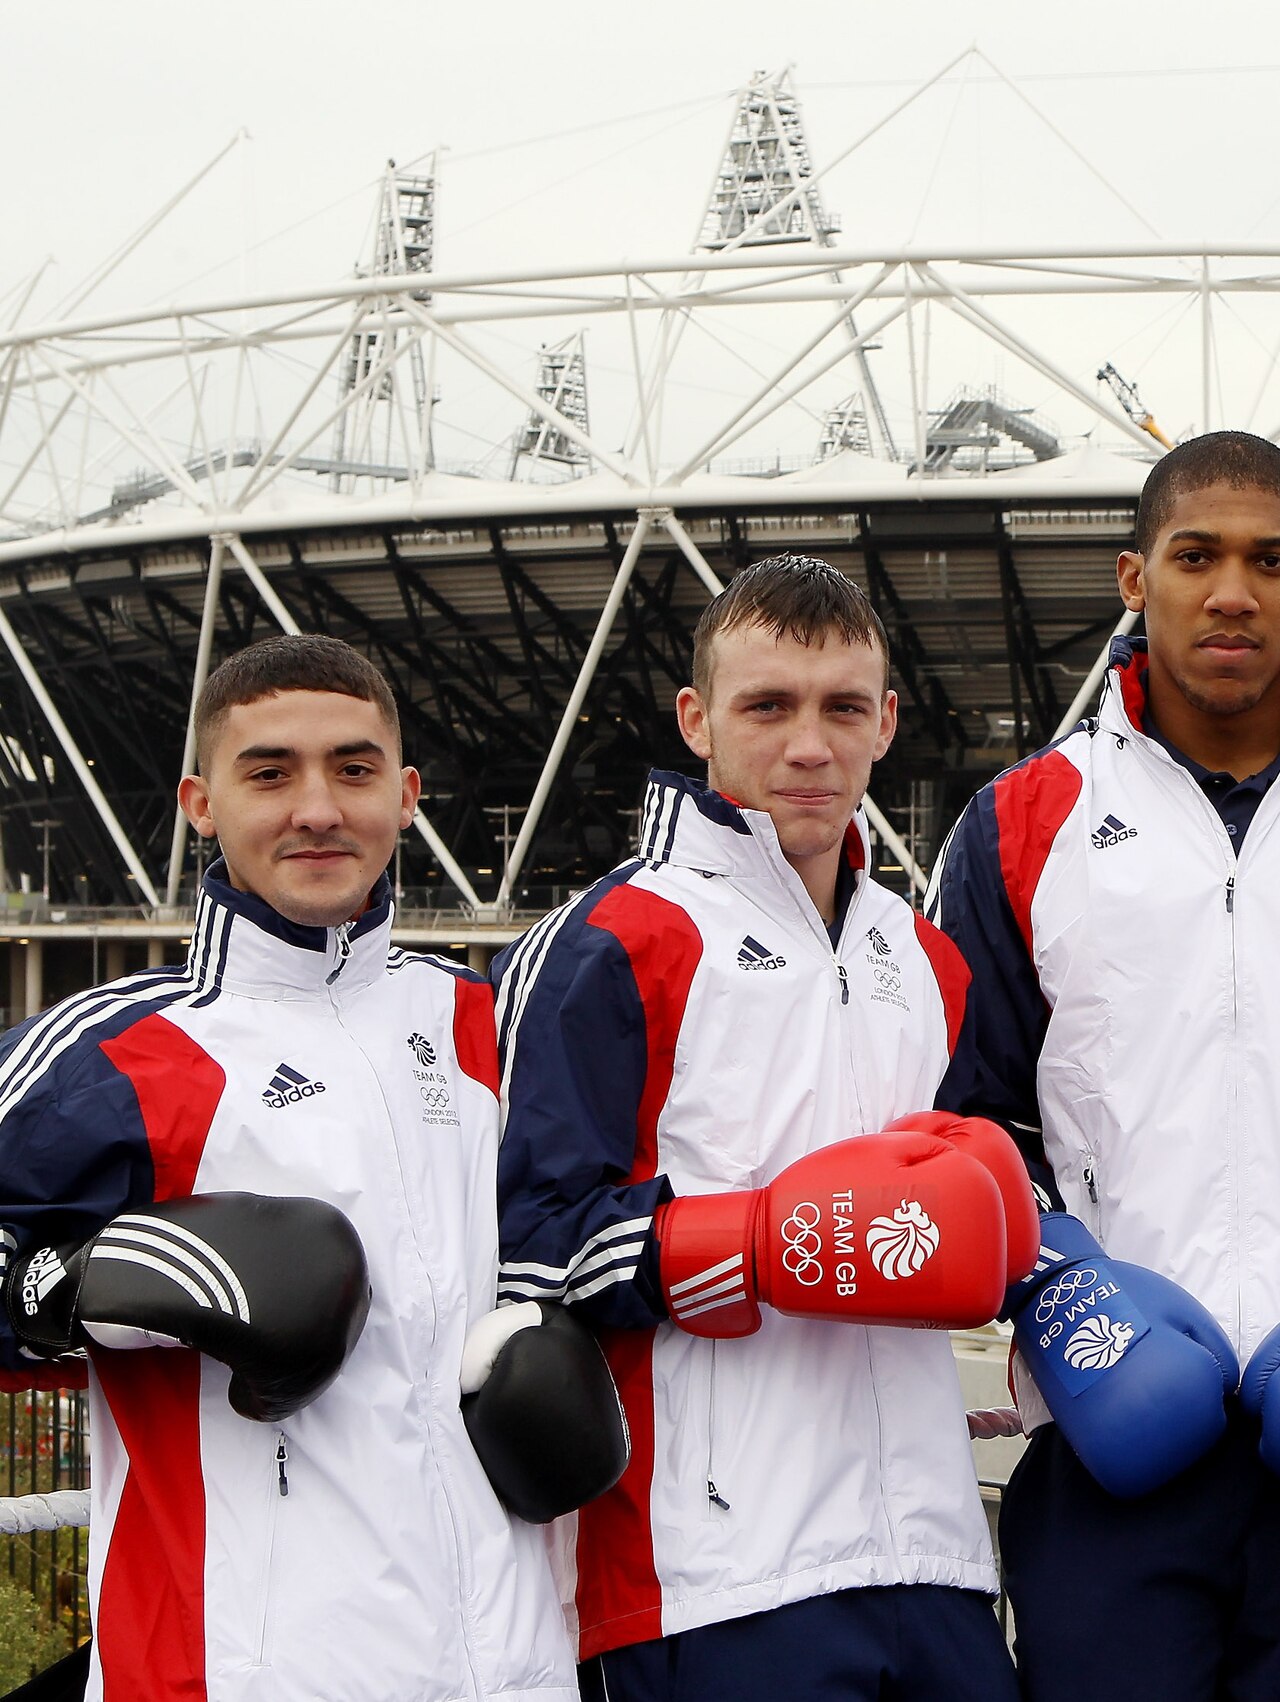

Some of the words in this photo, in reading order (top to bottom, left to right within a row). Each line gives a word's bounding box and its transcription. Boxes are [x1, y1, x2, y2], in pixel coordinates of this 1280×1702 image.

[1091, 828, 1138, 849] didas
[865, 954, 889, 968] TEAM
[890, 962, 901, 974] GB
[412, 1069, 435, 1082] TEAM
[262, 1081, 326, 1109] adidas
[832, 1189, 855, 1254] TEAM
[22, 1247, 51, 1316] adidas
[835, 1262, 857, 1296] GB
[1064, 1282, 1120, 1322] TEAM
[1040, 1322, 1063, 1348] GB
